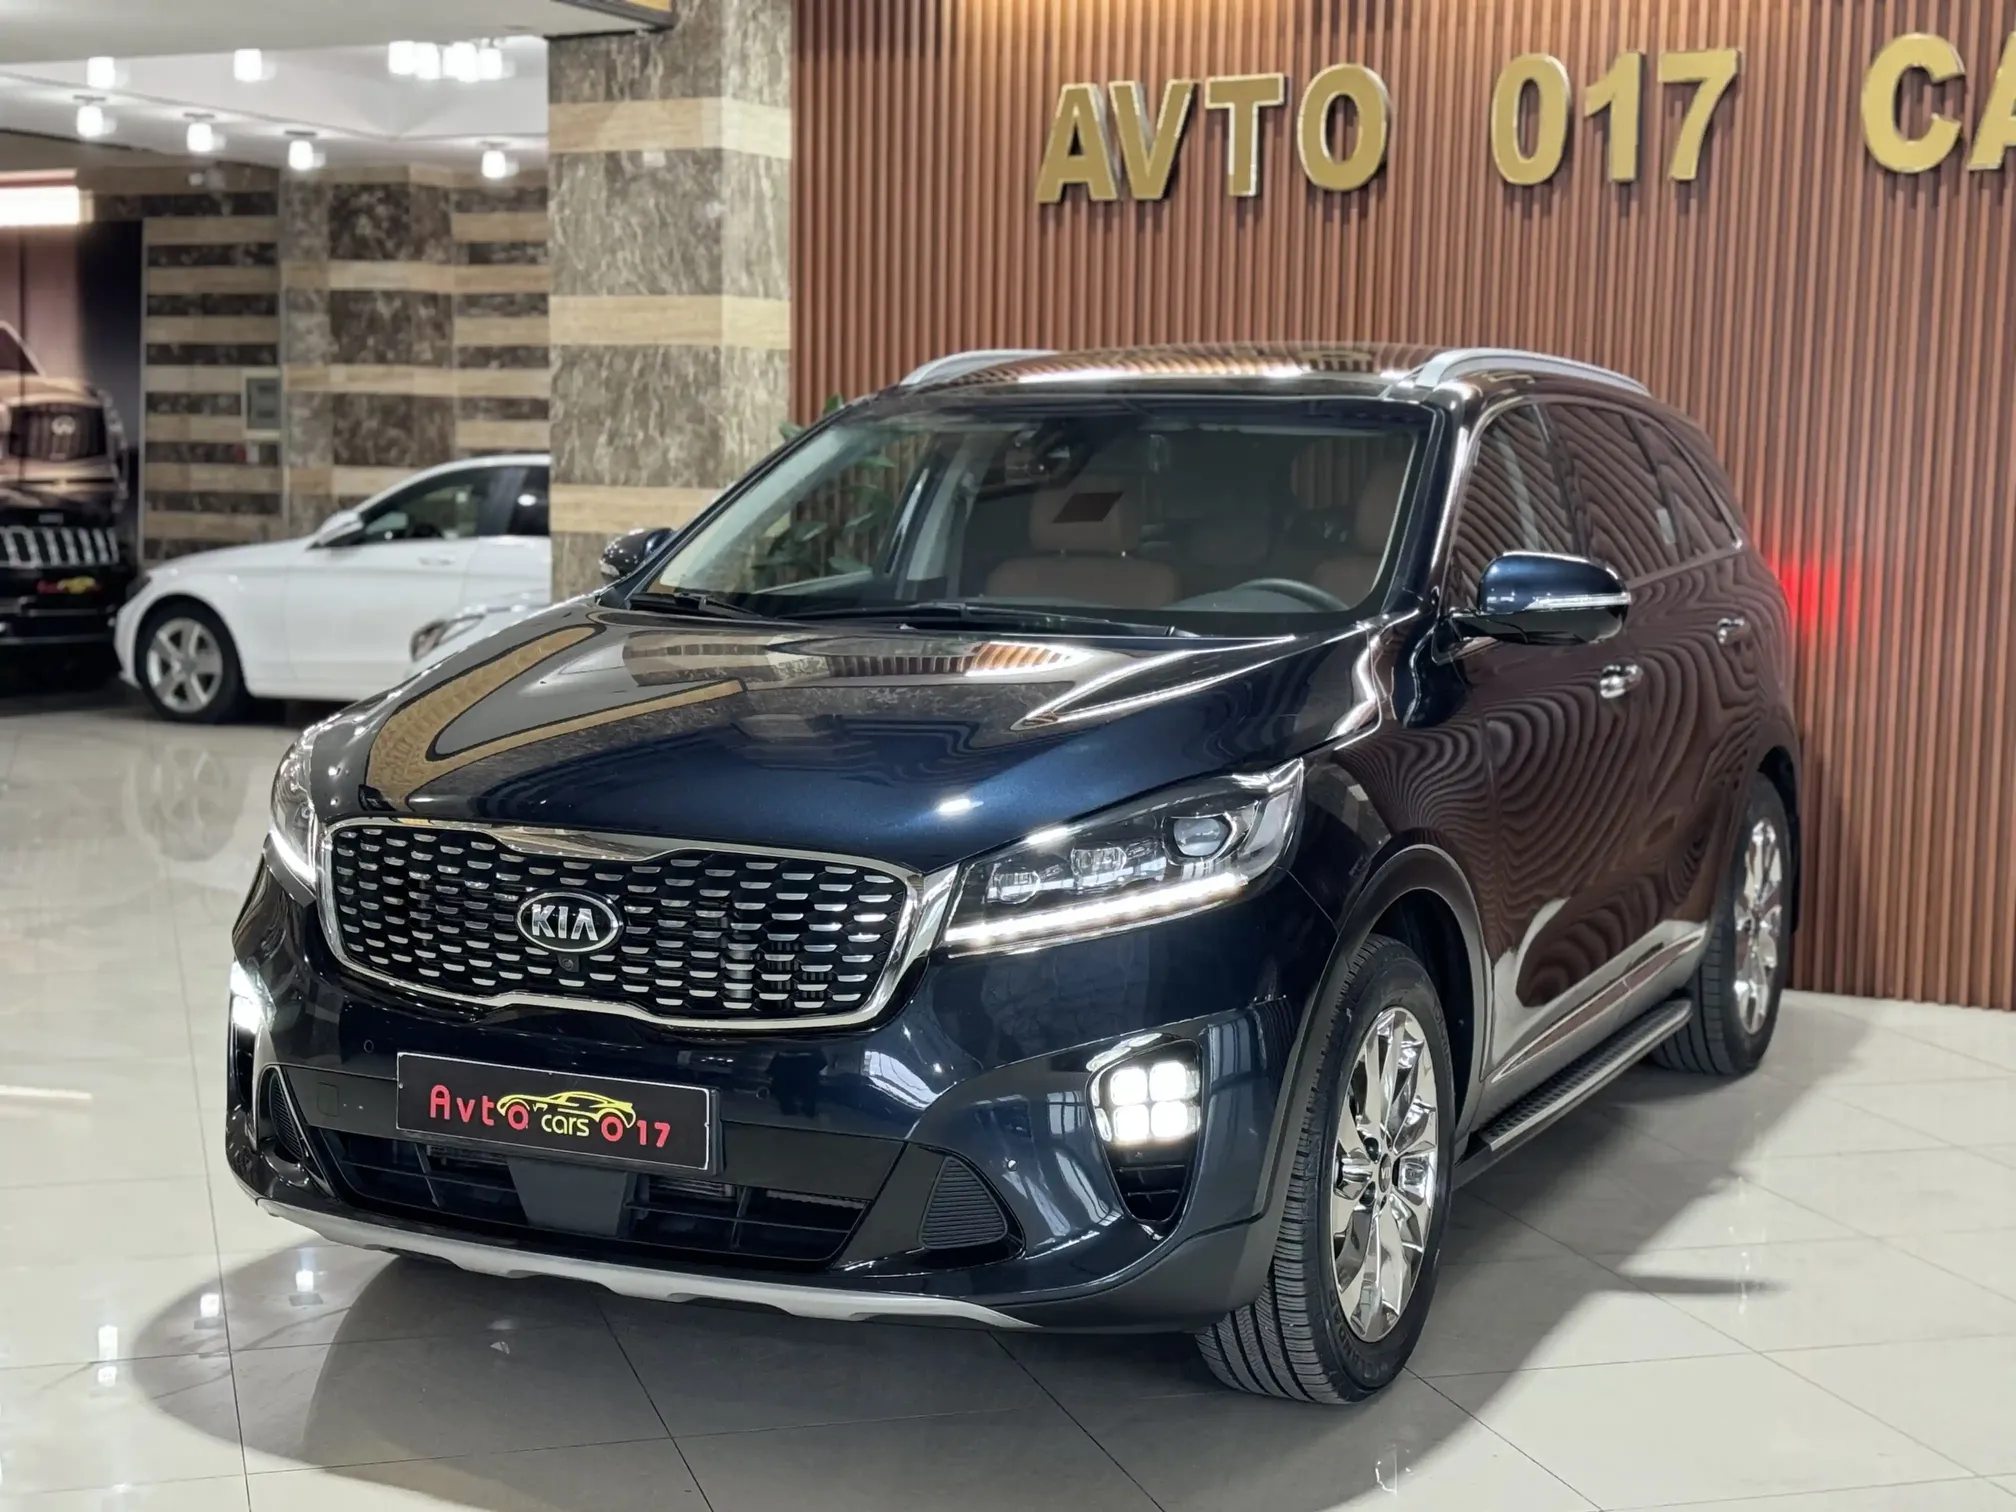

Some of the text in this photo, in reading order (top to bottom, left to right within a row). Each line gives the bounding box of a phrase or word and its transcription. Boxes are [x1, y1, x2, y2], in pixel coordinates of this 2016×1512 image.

[1035, 62, 1391, 204] AVTO
[1489, 48, 1743, 187] 017
[531, 903, 599, 941] KIA
[541, 1112, 590, 1137] cars
